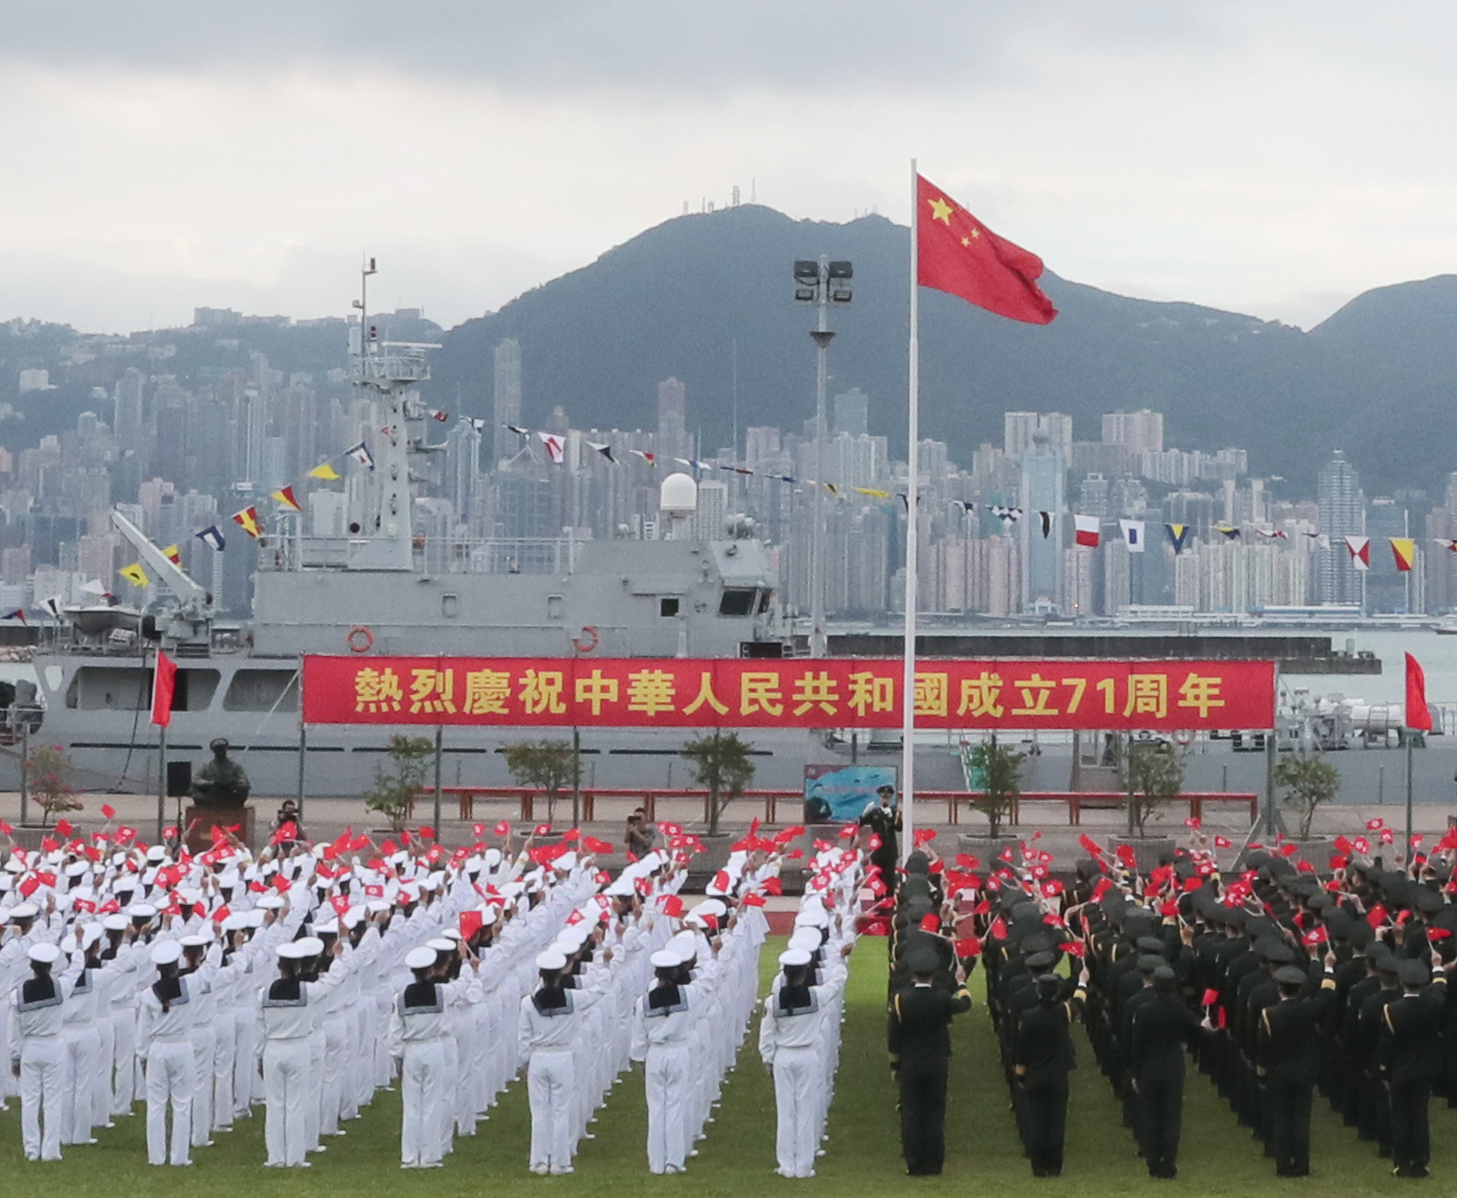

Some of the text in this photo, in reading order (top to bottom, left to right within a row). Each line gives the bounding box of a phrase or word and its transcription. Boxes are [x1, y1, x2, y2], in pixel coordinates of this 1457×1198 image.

[354, 667, 1225, 719] 熱烈慶祝中華人民共和國成立71周年
